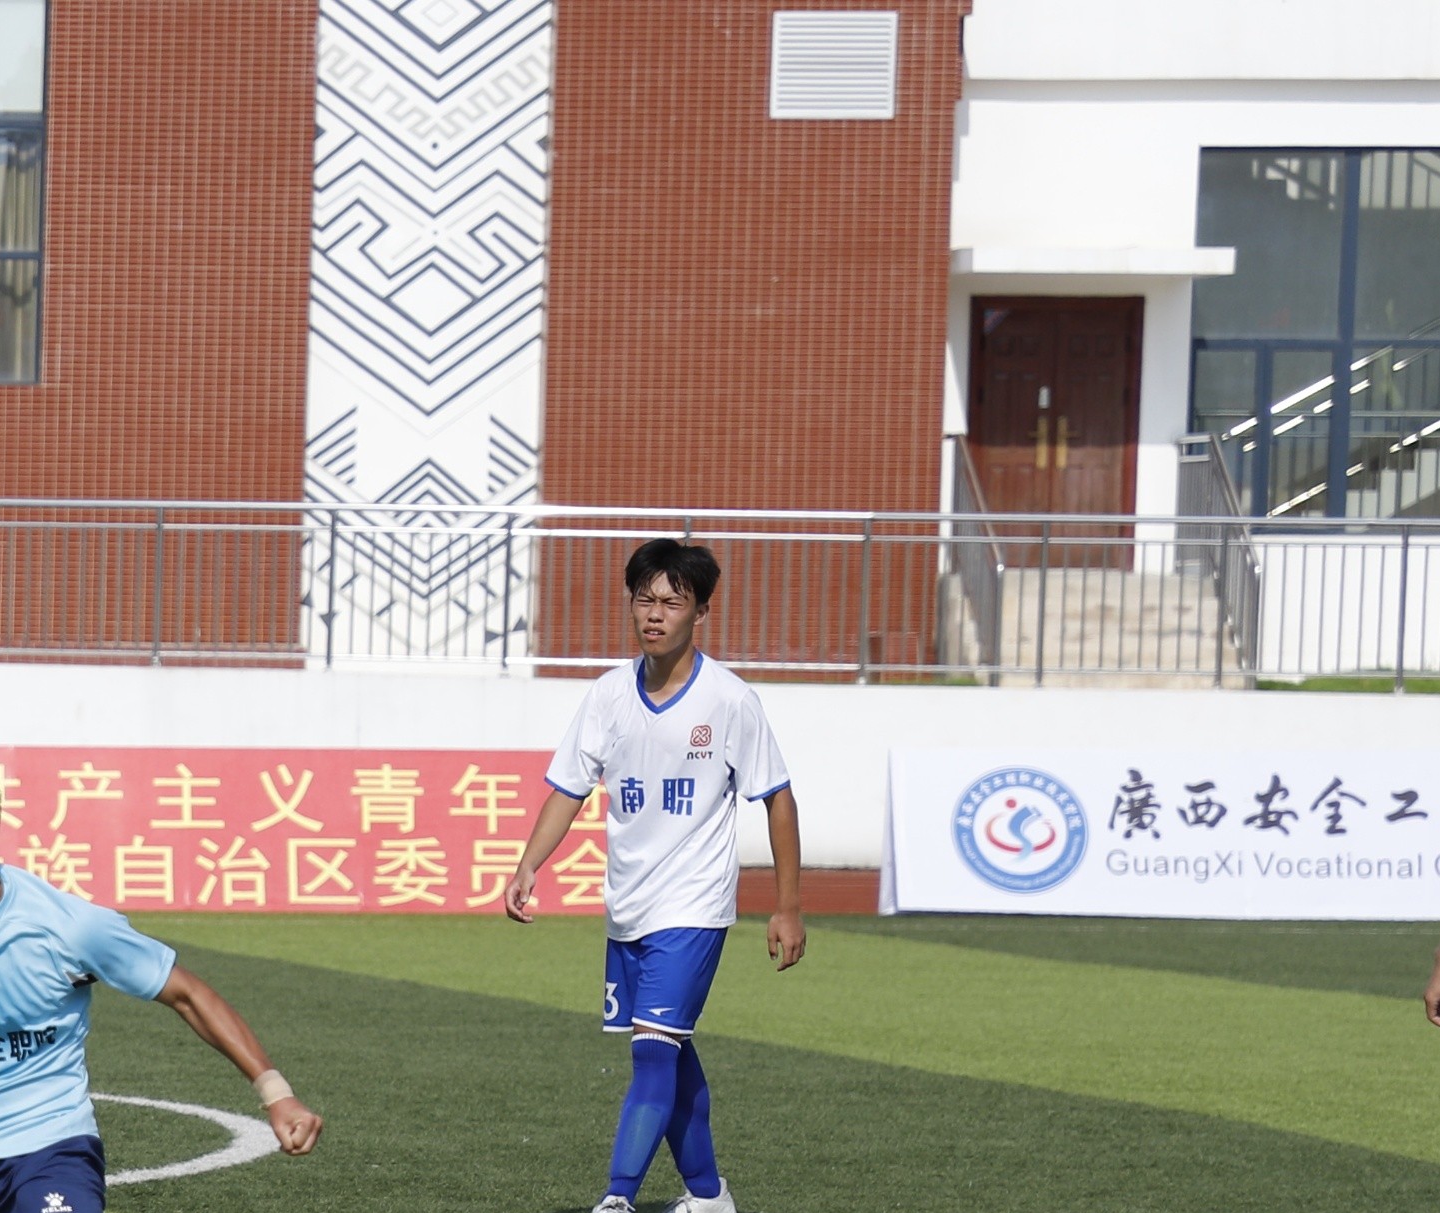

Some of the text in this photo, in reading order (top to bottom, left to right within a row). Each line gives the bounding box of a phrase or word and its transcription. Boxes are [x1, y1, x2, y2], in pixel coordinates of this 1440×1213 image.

[620, 777, 695, 816] 南职
[1105, 848, 1243, 884] GuangXi
[1253, 852, 1423, 879] Vocational
